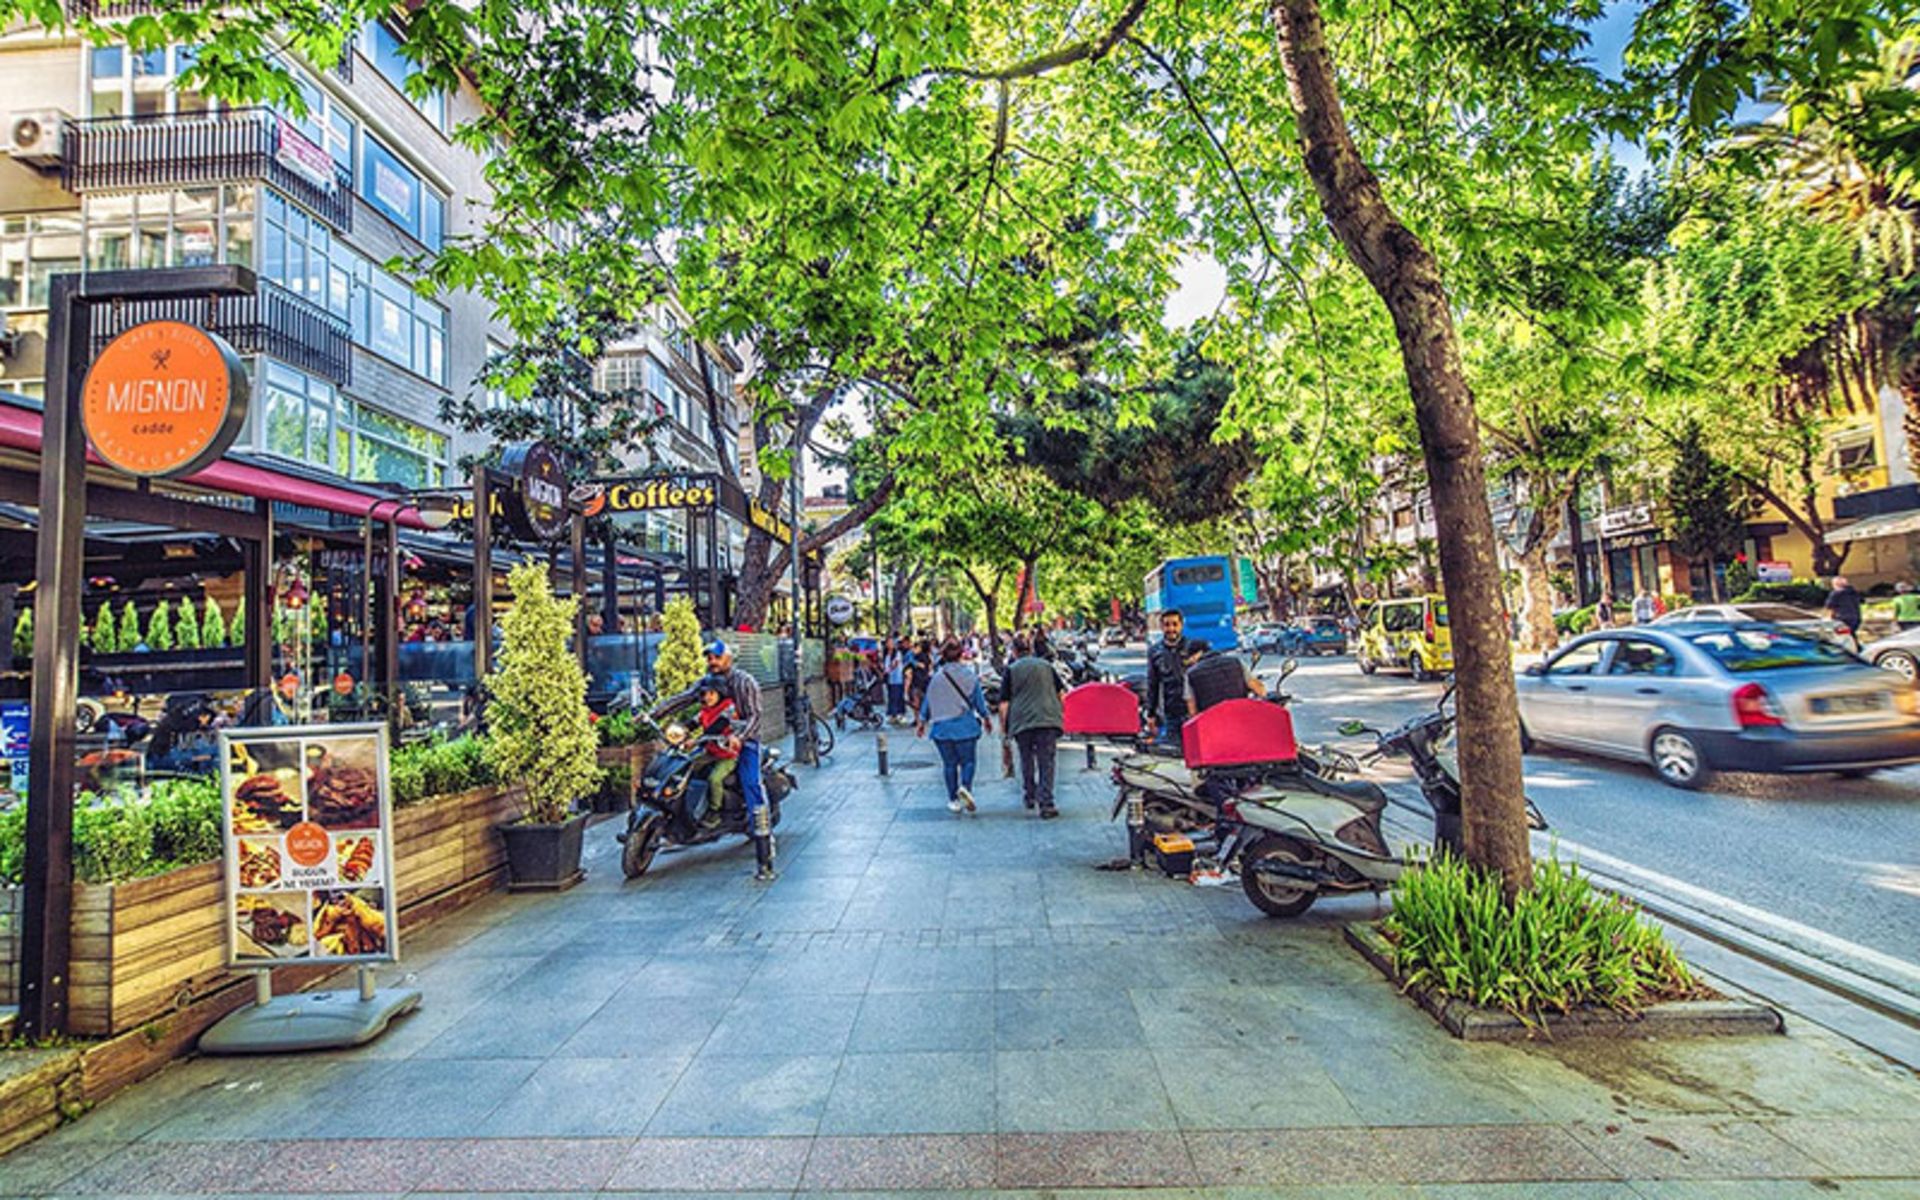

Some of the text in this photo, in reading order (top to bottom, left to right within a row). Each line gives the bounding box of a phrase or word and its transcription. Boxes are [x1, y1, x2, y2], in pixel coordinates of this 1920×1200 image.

[106, 378, 208, 413] MIGNON
[132, 422, 174, 435] cadde
[609, 481, 715, 511] Coffees
